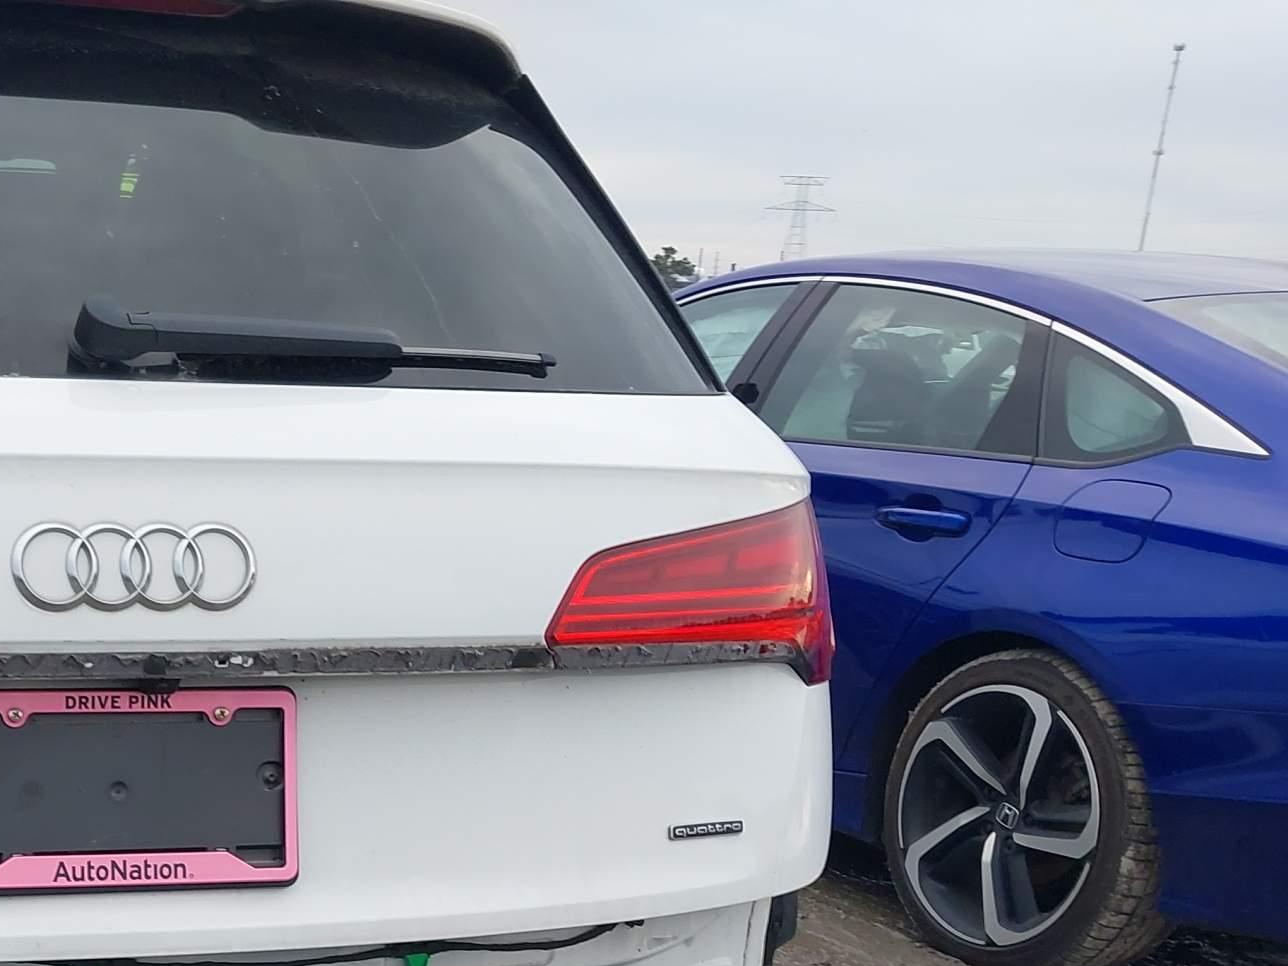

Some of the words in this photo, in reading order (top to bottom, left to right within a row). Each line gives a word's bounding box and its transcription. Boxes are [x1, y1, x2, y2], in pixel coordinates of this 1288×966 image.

[65, 695, 121, 710] DRIVE
[128, 694, 172, 709] PINK
[674, 822, 742, 838] quattro
[52, 859, 187, 883] AutoNation
